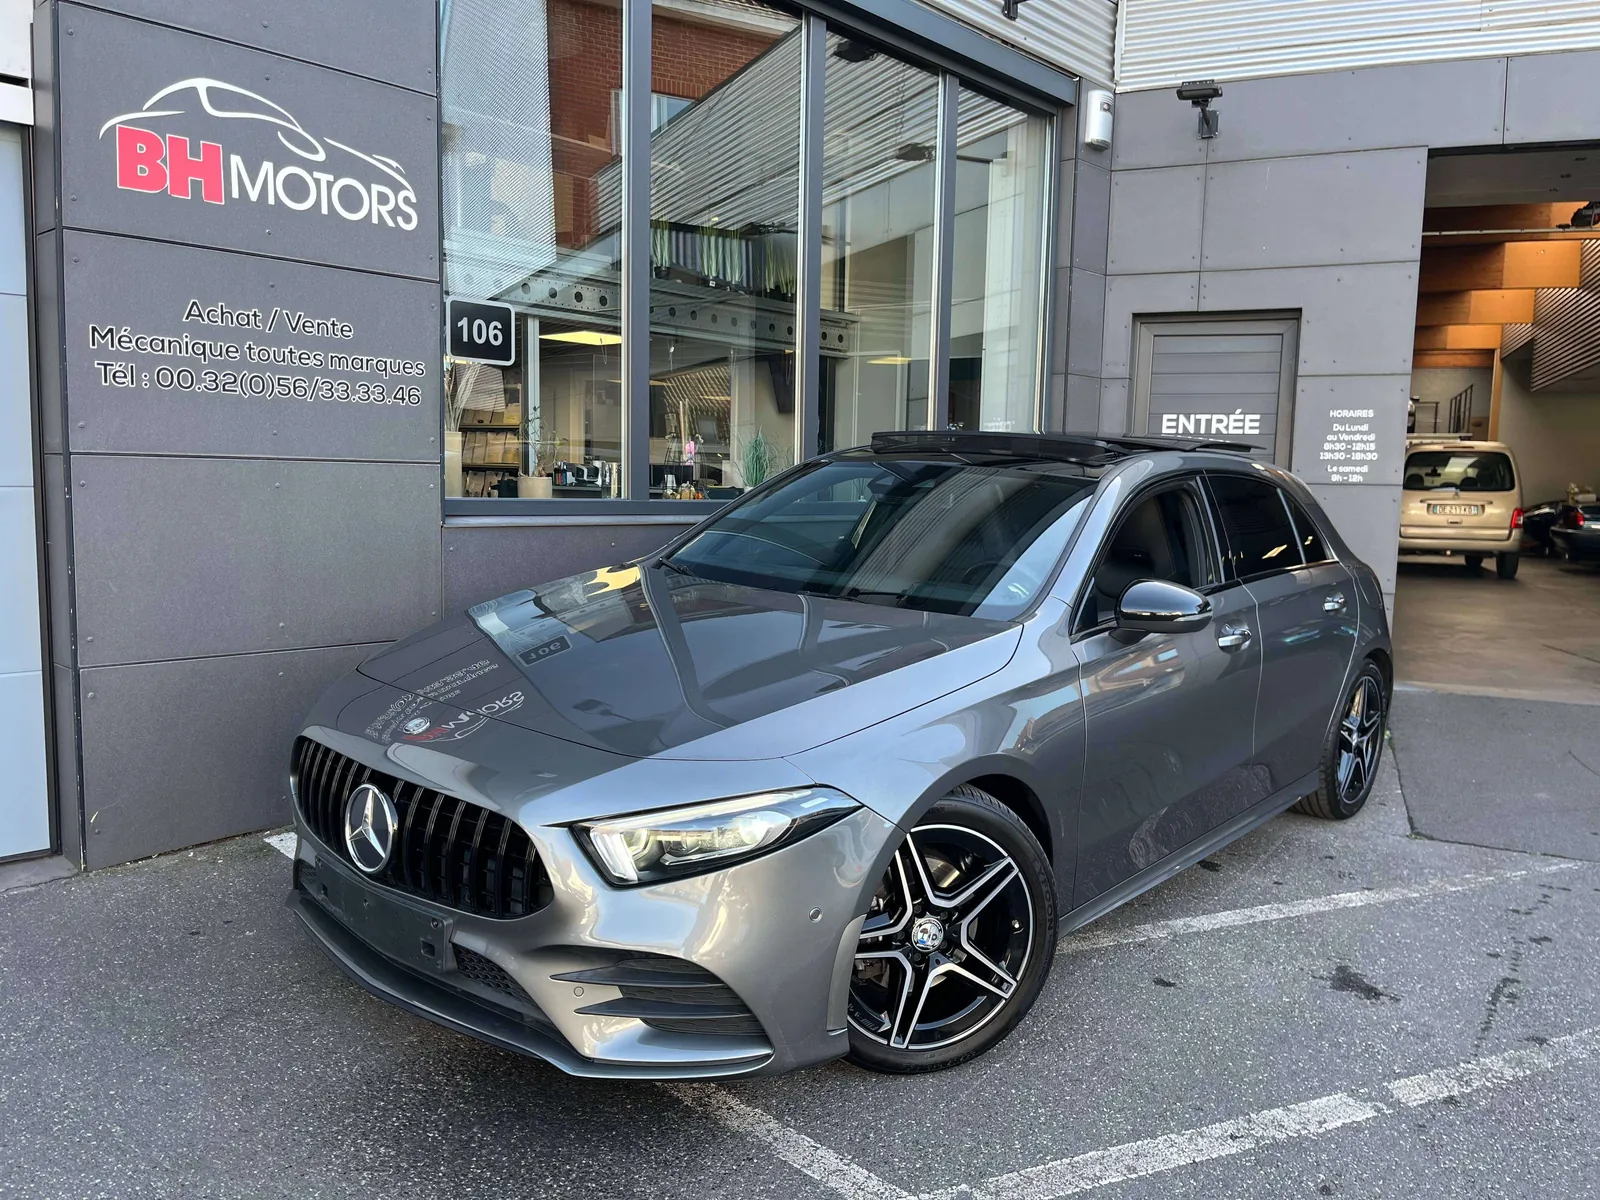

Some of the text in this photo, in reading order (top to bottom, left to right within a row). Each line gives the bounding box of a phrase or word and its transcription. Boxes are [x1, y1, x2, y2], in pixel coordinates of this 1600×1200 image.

[116, 124, 418, 231] BH MOTORS
[183, 300, 353, 339] Achat / Vente
[457, 316, 503, 346] 106
[89, 324, 426, 380] Mécanique toutes marques
[95, 360, 136, 388] Tél
[154, 366, 422, 407] 00.32(0)56/33.33.46
[1161, 409, 1261, 434] ENTRÉE
[1329, 409, 1374, 418] HORAIRES
[1333, 423, 1369, 431] Du Lundi
[1338, 433, 1376, 441] Vendredi
[1320, 452, 1345, 460] 13h30
